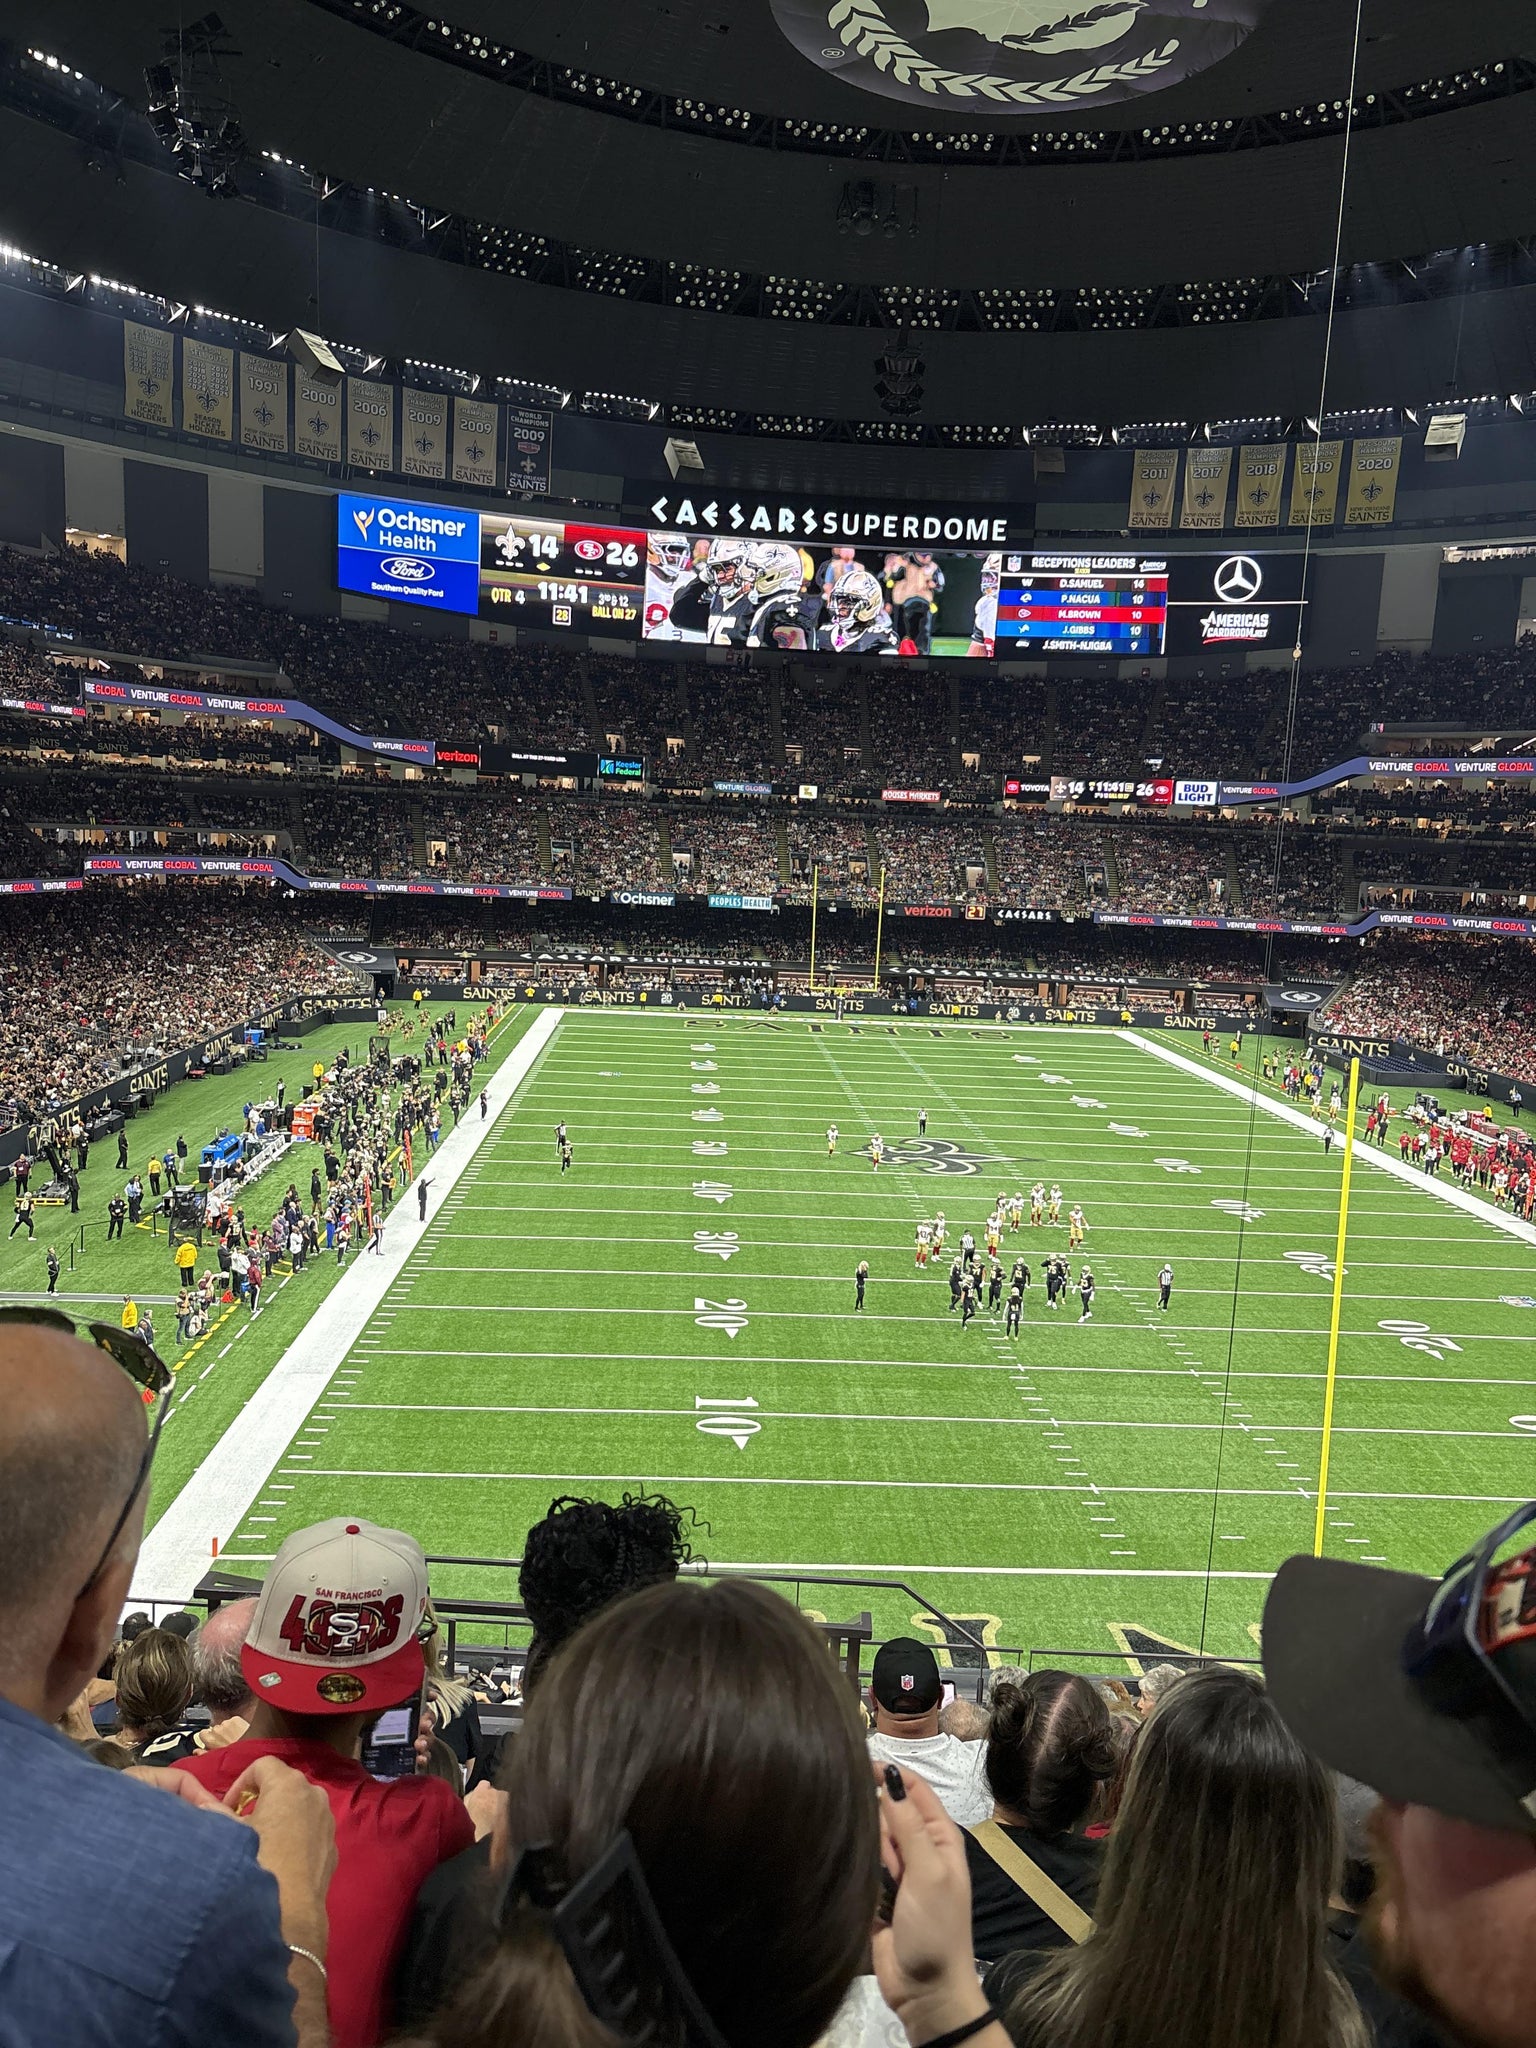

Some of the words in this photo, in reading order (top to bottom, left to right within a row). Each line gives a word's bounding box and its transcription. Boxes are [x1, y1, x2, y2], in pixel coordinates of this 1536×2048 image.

[248, 376, 279, 396] 1991
[301, 386, 336, 405] 2000
[354, 400, 387, 417] 2006
[194, 413, 221, 424] SEASON
[409, 409, 441, 426] 2009
[510, 416, 549, 427] CHAMPIONS
[518, 411, 542, 420] WORLD
[189, 424, 226, 437] HOLDERS
[195, 419, 221, 429] TICKET
[460, 418, 492, 435] 2009
[244, 432, 285, 450] SAINTS
[513, 427, 545, 442] 2009
[298, 442, 338, 459] SAINTS
[350, 453, 390, 469] SAINTS
[1301, 461, 1333, 474] 2019
[1357, 457, 1393, 471] 2020
[405, 462, 442, 477] SAINTS
[1141, 468, 1168, 479] 2011
[1192, 467, 1223, 479] 2017
[1246, 464, 1278, 476] 2018
[455, 470, 493, 484] SAINTS
[509, 477, 546, 491] SAINTS
[377, 508, 466, 537] Ochsner
[651, 496, 818, 535] CAESARS
[822, 510, 1008, 542] SUPERDOME
[1131, 517, 1168, 526] SAINTS
[1183, 518, 1221, 527] SAINTS
[1237, 514, 1276, 525] SAINTS
[1291, 513, 1332, 524] SAINTS
[1348, 511, 1389, 522] SAINTS
[379, 530, 437, 552] Health
[528, 533, 559, 559] 14
[606, 541, 639, 567] 26
[390, 559, 425, 578] Ford
[1031, 556, 1091, 569] RECEPTIONS
[1092, 557, 1136, 570] LEADERS
[371, 581, 403, 593] Southern
[403, 585, 428, 597] Quality
[428, 587, 444, 598] Ford
[1059, 578, 1105, 589] D.SAMUEL
[1133, 579, 1145, 589] 14
[491, 587, 512, 604] QTR
[515, 590, 526, 605] 4
[537, 581, 589, 604] 11:41
[619, 595, 629, 607] 12
[1060, 594, 1101, 604] P.NACUA
[1132, 594, 1144, 604] 10
[556, 609, 569, 622] 28
[591, 605, 611, 618] BALL
[612, 608, 624, 619] ON
[625, 609, 637, 621] 27
[1058, 609, 1102, 619] M.BROWN
[1131, 610, 1142, 620] 10
[1205, 611, 1269, 628] AMERICAS
[1062, 626, 1095, 635] J.GIBBS
[1130, 626, 1142, 636] 10
[1206, 627, 1268, 638] CARDROOM.NET
[1042, 639, 1112, 651] J.SMITH-NJIGBA
[1130, 641, 1138, 651] 9
[95, 684, 127, 697] GLOBAL
[131, 689, 169, 702] VENTURE
[170, 693, 203, 706] GLOBAL
[207, 697, 246, 711] VENTURE
[247, 700, 286, 713] GLOBAL
[373, 741, 403, 752] VENTURE
[404, 743, 429, 753] GLOBAL
[436, 750, 478, 763] verizon
[615, 760, 642, 769] Keesler
[1369, 761, 1413, 772] VENTURE
[1414, 762, 1449, 772] GLOBAL
[1454, 762, 1497, 772] VENTURE
[1498, 762, 1534, 772] GLOBAL
[615, 768, 642, 776] Federal
[714, 783, 745, 792] VENTURE
[745, 784, 772, 793] GLOBAL
[1020, 784, 1050, 792] TOYOTA
[1068, 782, 1084, 794] 14
[1096, 781, 1125, 792] 11:41
[1136, 783, 1154, 796] 26
[1183, 783, 1209, 794] BUD
[1222, 786, 1252, 795] VENTURE
[1253, 787, 1279, 795] GLOBAL
[882, 790, 908, 800] ROUSES
[909, 791, 940, 801] MARKETS
[1178, 792, 1213, 803] LIGHT
[1436, 811, 1468, 820] SAINTS
[92, 860, 122, 869] GLOBAL
[126, 860, 163, 869] VENTURE
[164, 860, 197, 870] GLOBAL
[201, 860, 241, 871] VENTURE
[242, 862, 274, 872] GLOBAL
[42, 881, 67, 891] VENTURE
[309, 881, 341, 890] VENTURE
[341, 882, 368, 891] GLOBAL
[376, 884, 408, 893] VENTURE
[408, 885, 435, 893] GLOBAL
[443, 886, 474, 895] VENTURE
[474, 887, 500, 896] GLOBAL
[508, 888, 538, 897] VENTURE
[538, 890, 565, 898] GLOBAL
[621, 892, 674, 906] Ochsner
[743, 899, 771, 909] HEALTH
[851, 901, 880, 910] SAINTS
[904, 906, 952, 917] verizon
[968, 906, 984, 918] 27
[997, 909, 1052, 921] CAESARS
[1060, 910, 1090, 919] SAINTS
[1100, 915, 1129, 923] VENTURE
[1129, 916, 1155, 924] GLOBAL
[1163, 918, 1192, 926] VENTURE
[1226, 921, 1256, 929] VENTURE
[1291, 925, 1321, 933] VENTURE
[1322, 926, 1347, 934] GLOBAL
[1380, 914, 1413, 923] VENTURE
[1413, 916, 1448, 926] GLOBAL
[1452, 918, 1492, 929] VENTURE
[1492, 921, 1527, 932] GLOBAL
[643, 957, 772, 968] SUPERDOME
[1008, 971, 1139, 984] SUPERDOME
[463, 987, 516, 999] SAINTS
[585, 989, 636, 1003] SAINTS
[1164, 1015, 1216, 1029] SAINTS
[684, 1019, 1013, 1041] SAINTS
[1317, 1034, 1390, 1057] SAINTS
[129, 1062, 169, 1092] SAINTS
[692, 1140, 729, 1156] 50
[1153, 1157, 1202, 1174] 50
[692, 1180, 734, 1199] 40
[1210, 1199, 1266, 1220] 40
[693, 1230, 740, 1253] 30
[1282, 1250, 1349, 1276] 30
[694, 1297, 749, 1328] 20
[1377, 1319, 1464, 1352] 20
[695, 1395, 762, 1436] 10
[315, 1587, 333, 1599] SAN
[335, 1588, 383, 1600] FRANCISCO
[327, 1612, 370, 1648] SF
